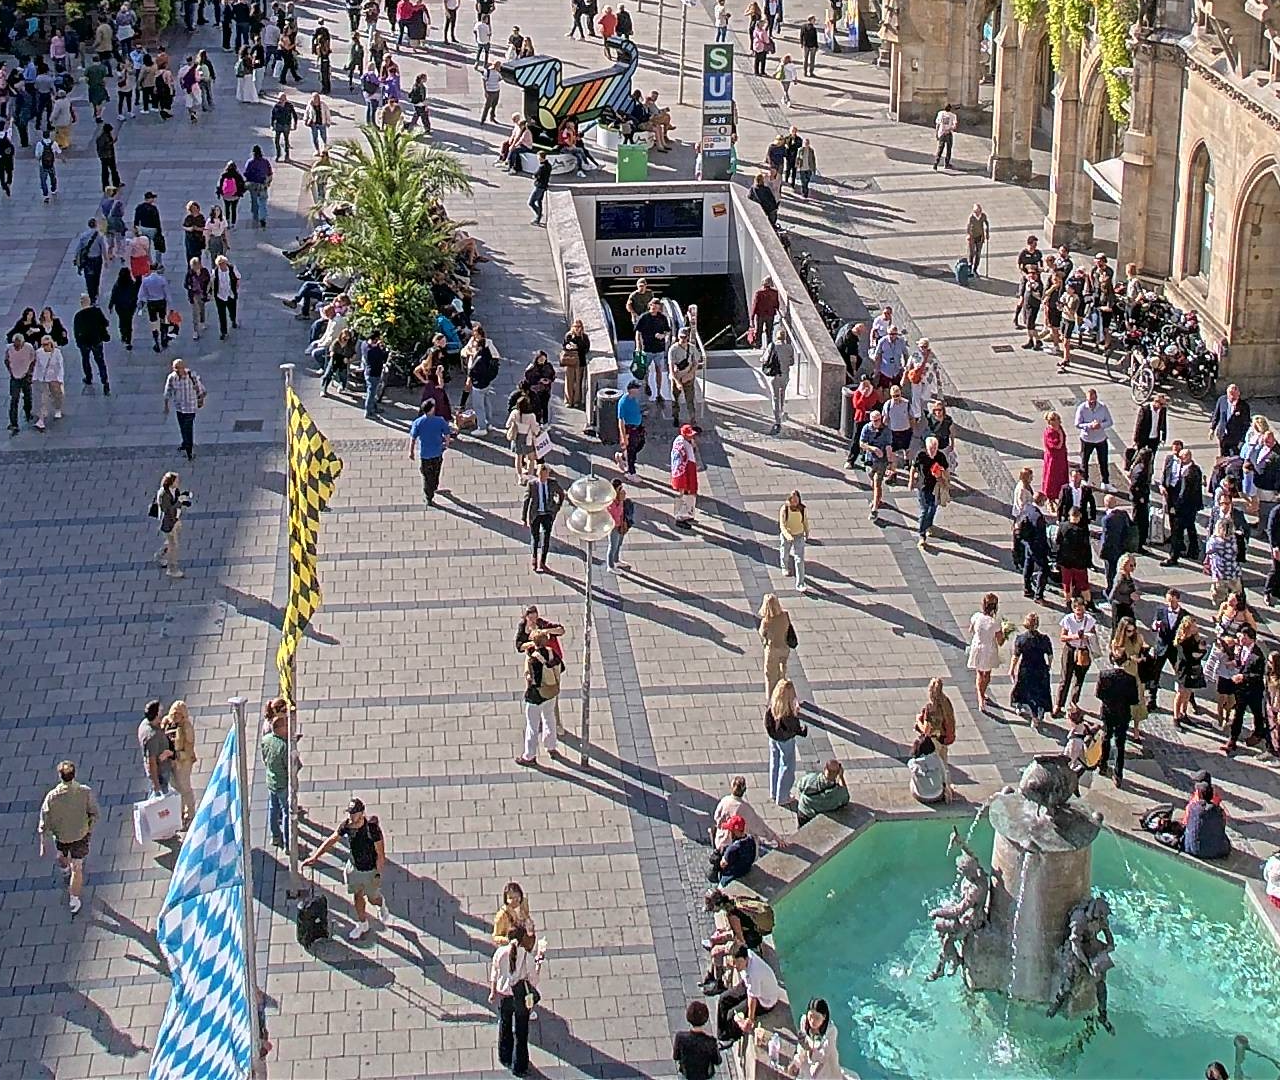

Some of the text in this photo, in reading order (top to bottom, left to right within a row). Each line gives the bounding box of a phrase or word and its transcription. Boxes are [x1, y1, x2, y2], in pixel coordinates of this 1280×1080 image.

[709, 48, 728, 70] S
[709, 76, 726, 97] U
[611, 245, 687, 258] Marienplatz
